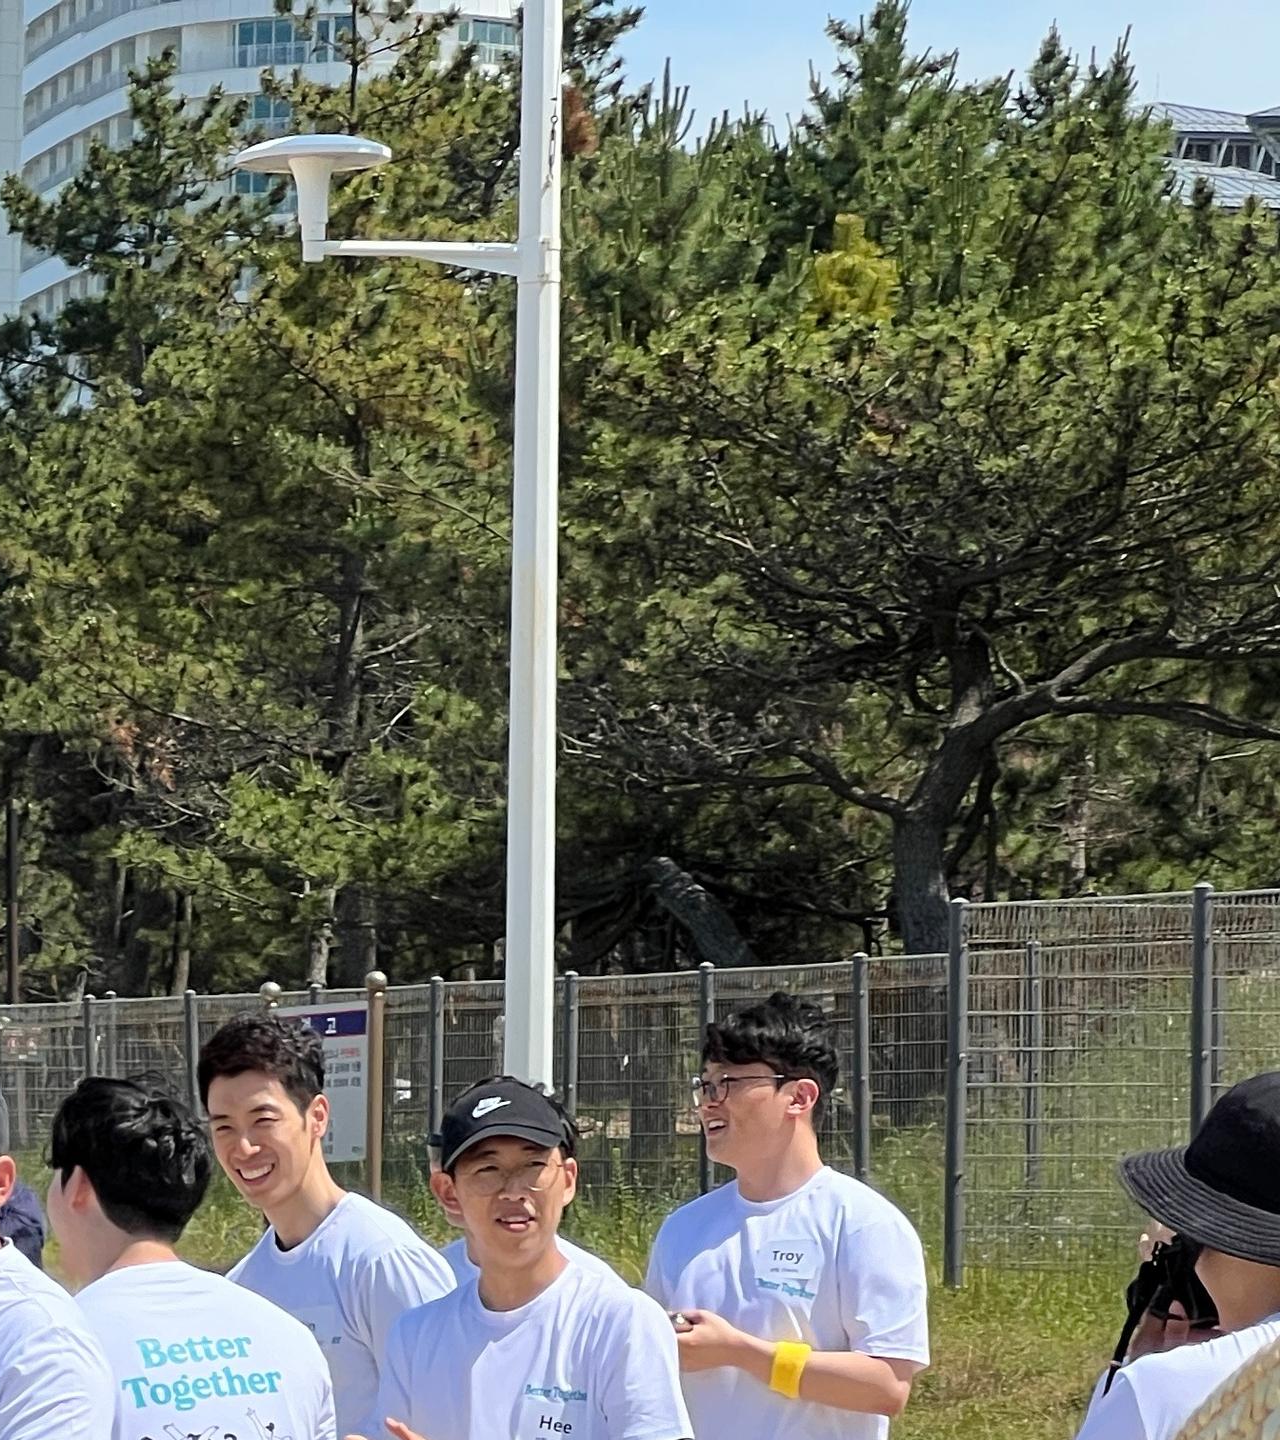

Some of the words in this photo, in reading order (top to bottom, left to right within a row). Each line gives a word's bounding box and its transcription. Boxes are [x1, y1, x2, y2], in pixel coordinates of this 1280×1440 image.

[772, 1249, 804, 1265] Troy
[136, 1335, 252, 1369] Better
[121, 1366, 282, 1412] Together
[539, 1414, 573, 1435] Hee
